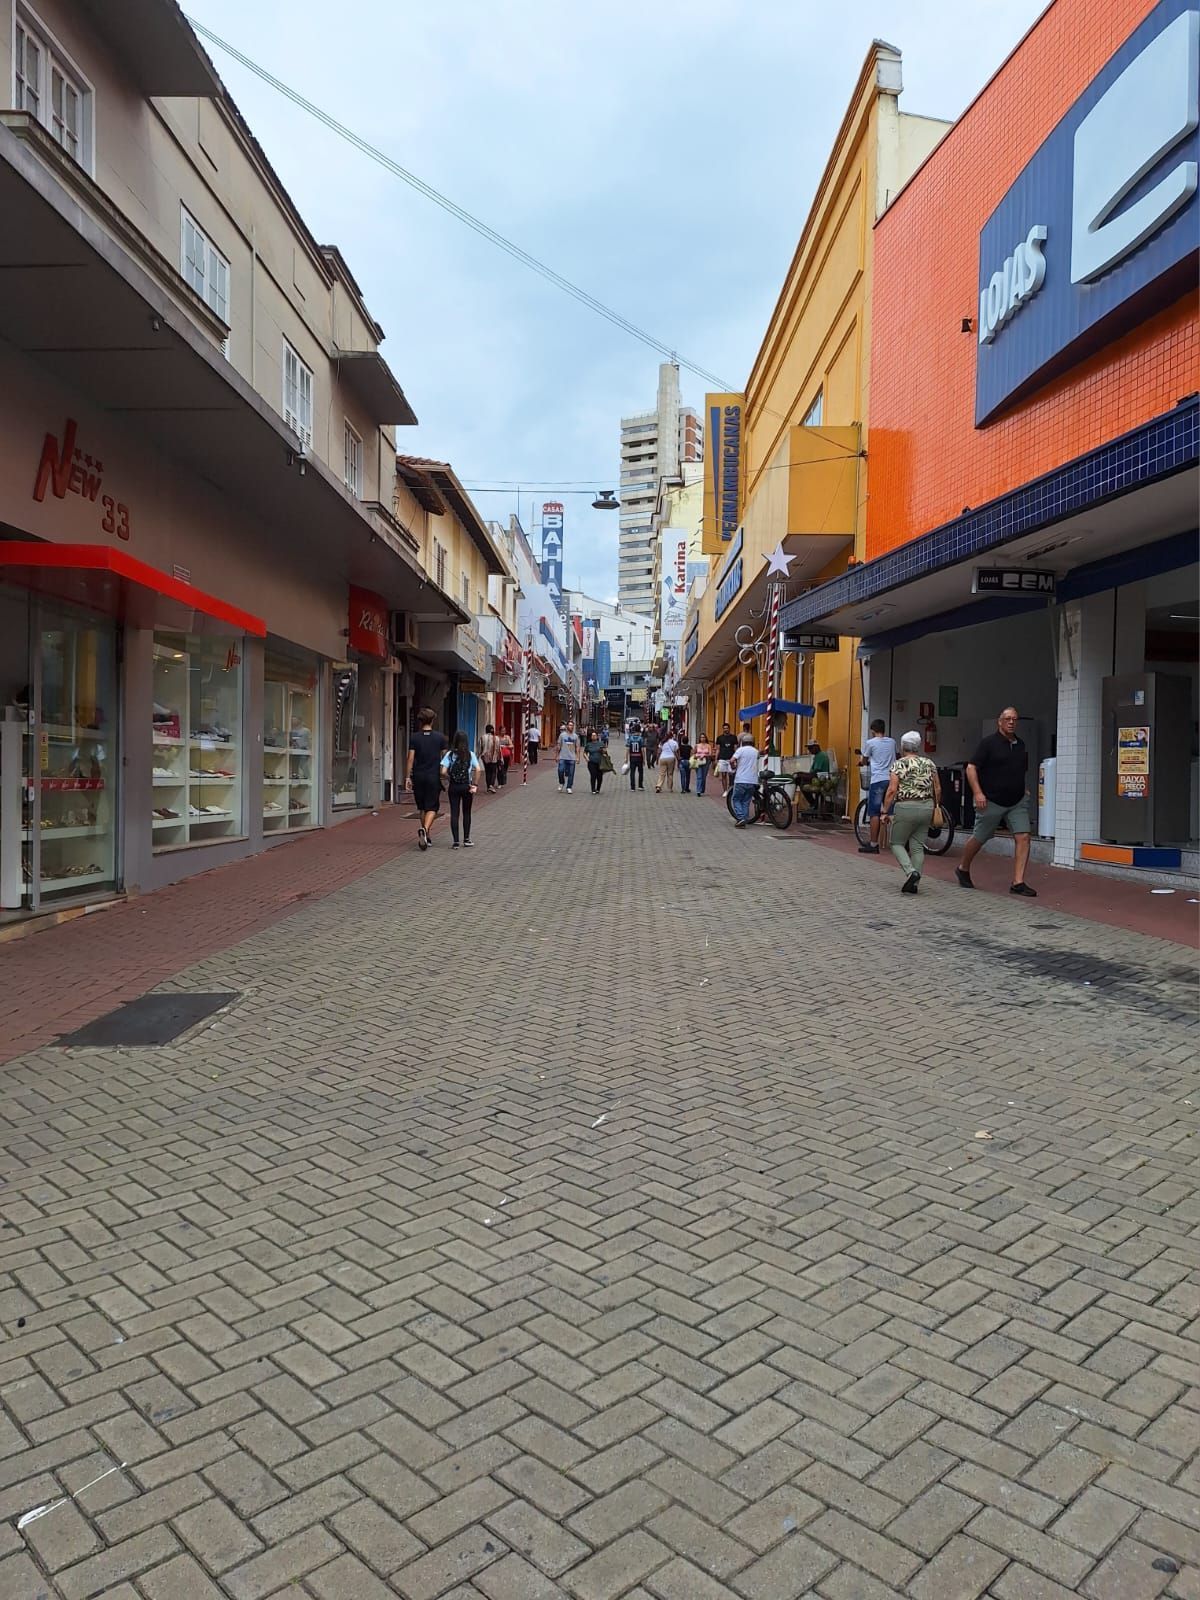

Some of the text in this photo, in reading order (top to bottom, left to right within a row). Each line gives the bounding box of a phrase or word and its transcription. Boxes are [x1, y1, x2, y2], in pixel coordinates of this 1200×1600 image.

[979, 224, 1047, 344] LOJAS
[722, 405, 740, 541] PERNAMBUCANAS
[102, 495, 129, 541] 33
[543, 514, 562, 596] BAHIA
[674, 541, 686, 593] Karina
[1002, 573, 1053, 590] CEM
[800, 635, 835, 647] CEM
[1120, 775, 1145, 784] BAIXA
